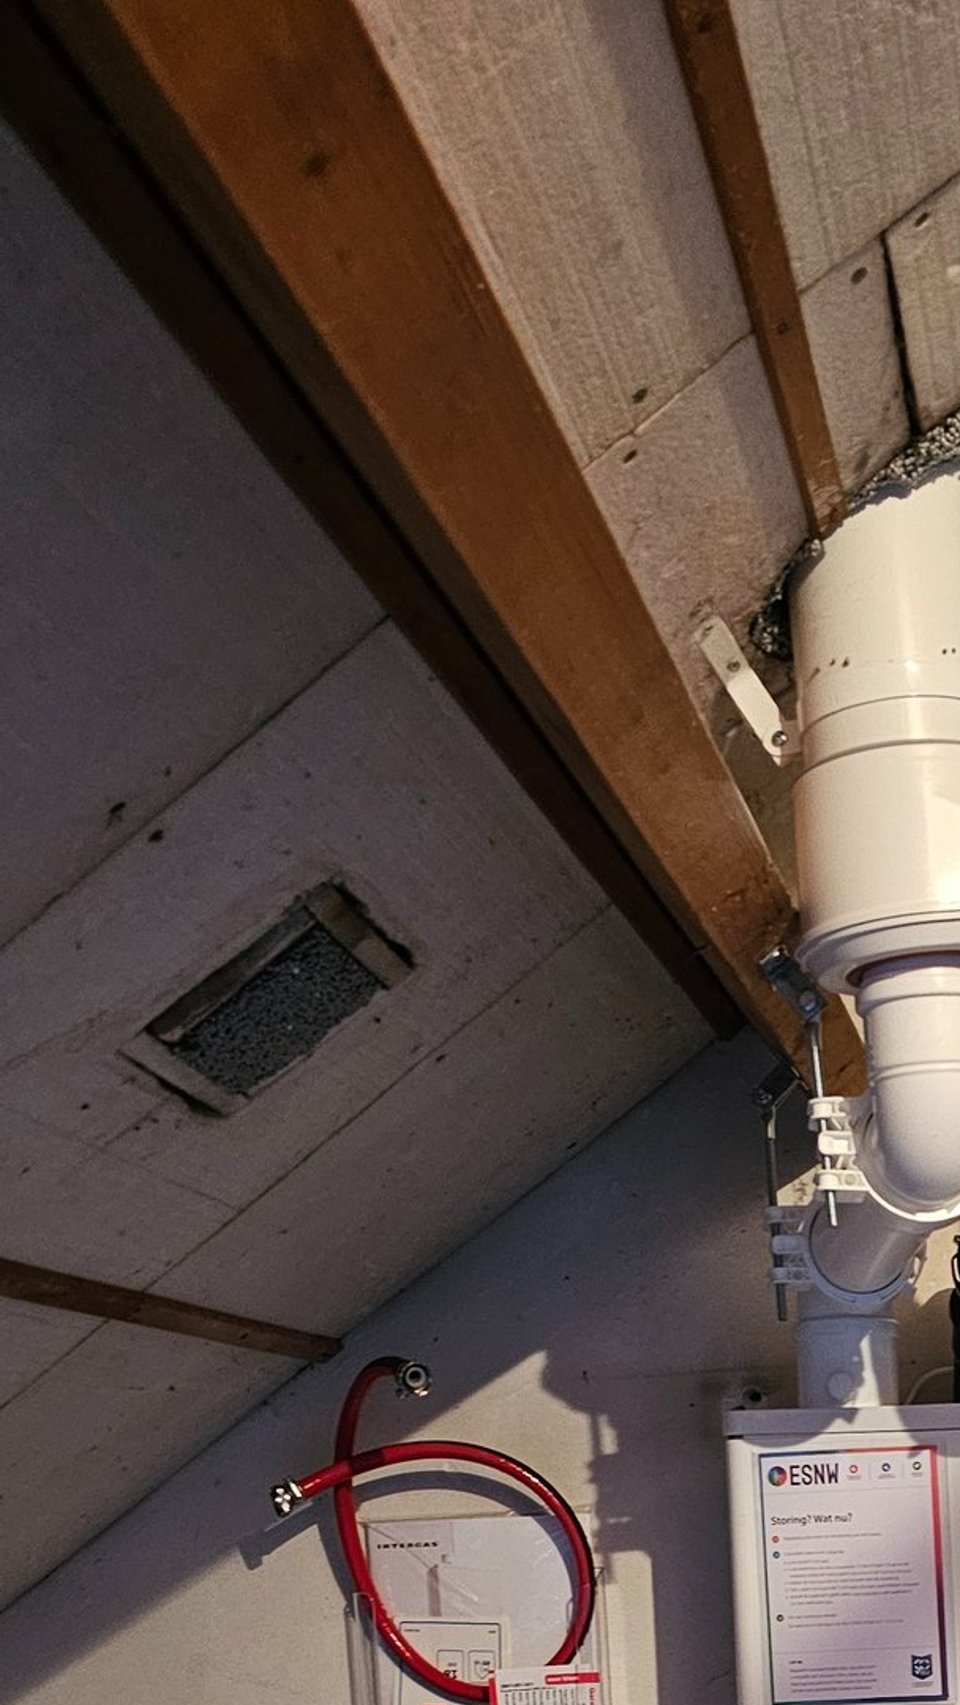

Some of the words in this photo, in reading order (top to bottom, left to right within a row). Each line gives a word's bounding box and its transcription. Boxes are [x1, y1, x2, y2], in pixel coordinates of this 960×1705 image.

[789, 1463, 839, 1486] ESNW
[771, 1515, 811, 1526] Storing?
[813, 1514, 833, 1523] Wat
[835, 1512, 852, 1522] nu?
